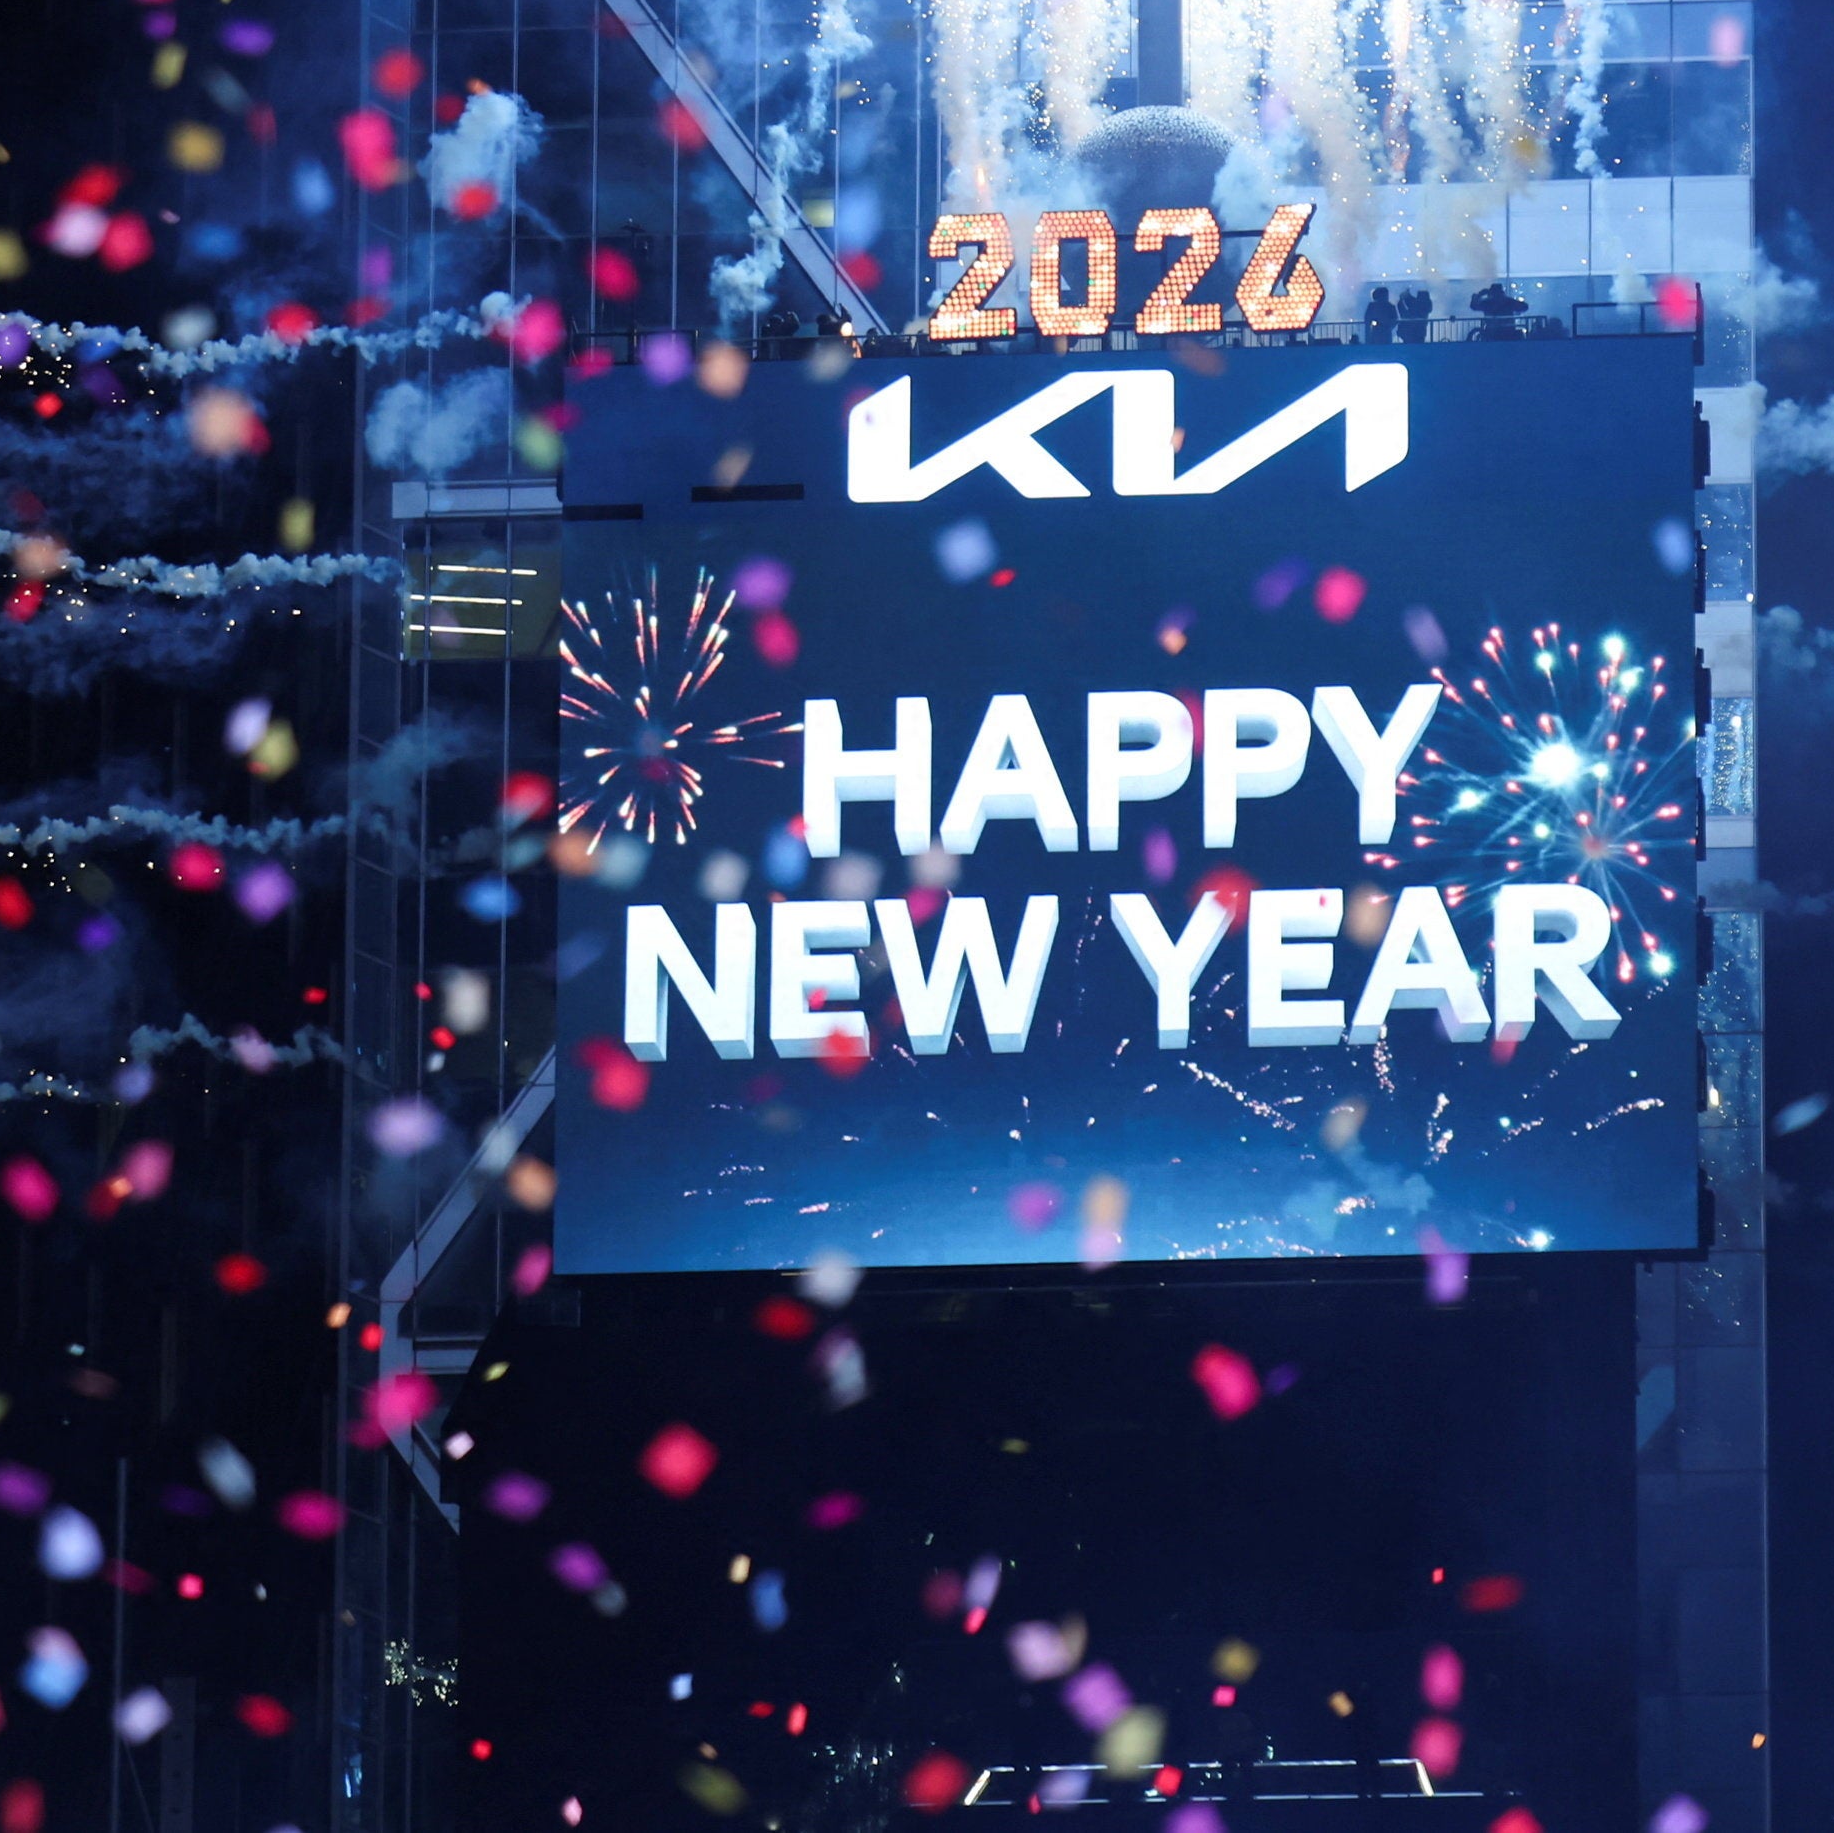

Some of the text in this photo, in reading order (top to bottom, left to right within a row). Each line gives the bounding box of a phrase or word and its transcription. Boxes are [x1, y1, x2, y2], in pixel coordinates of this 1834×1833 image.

[927, 202, 1325, 339] 2026
[848, 363, 1408, 502] KIA
[803, 684, 1442, 858] HAPPY
[623, 884, 1621, 1061] NEW YEAR
